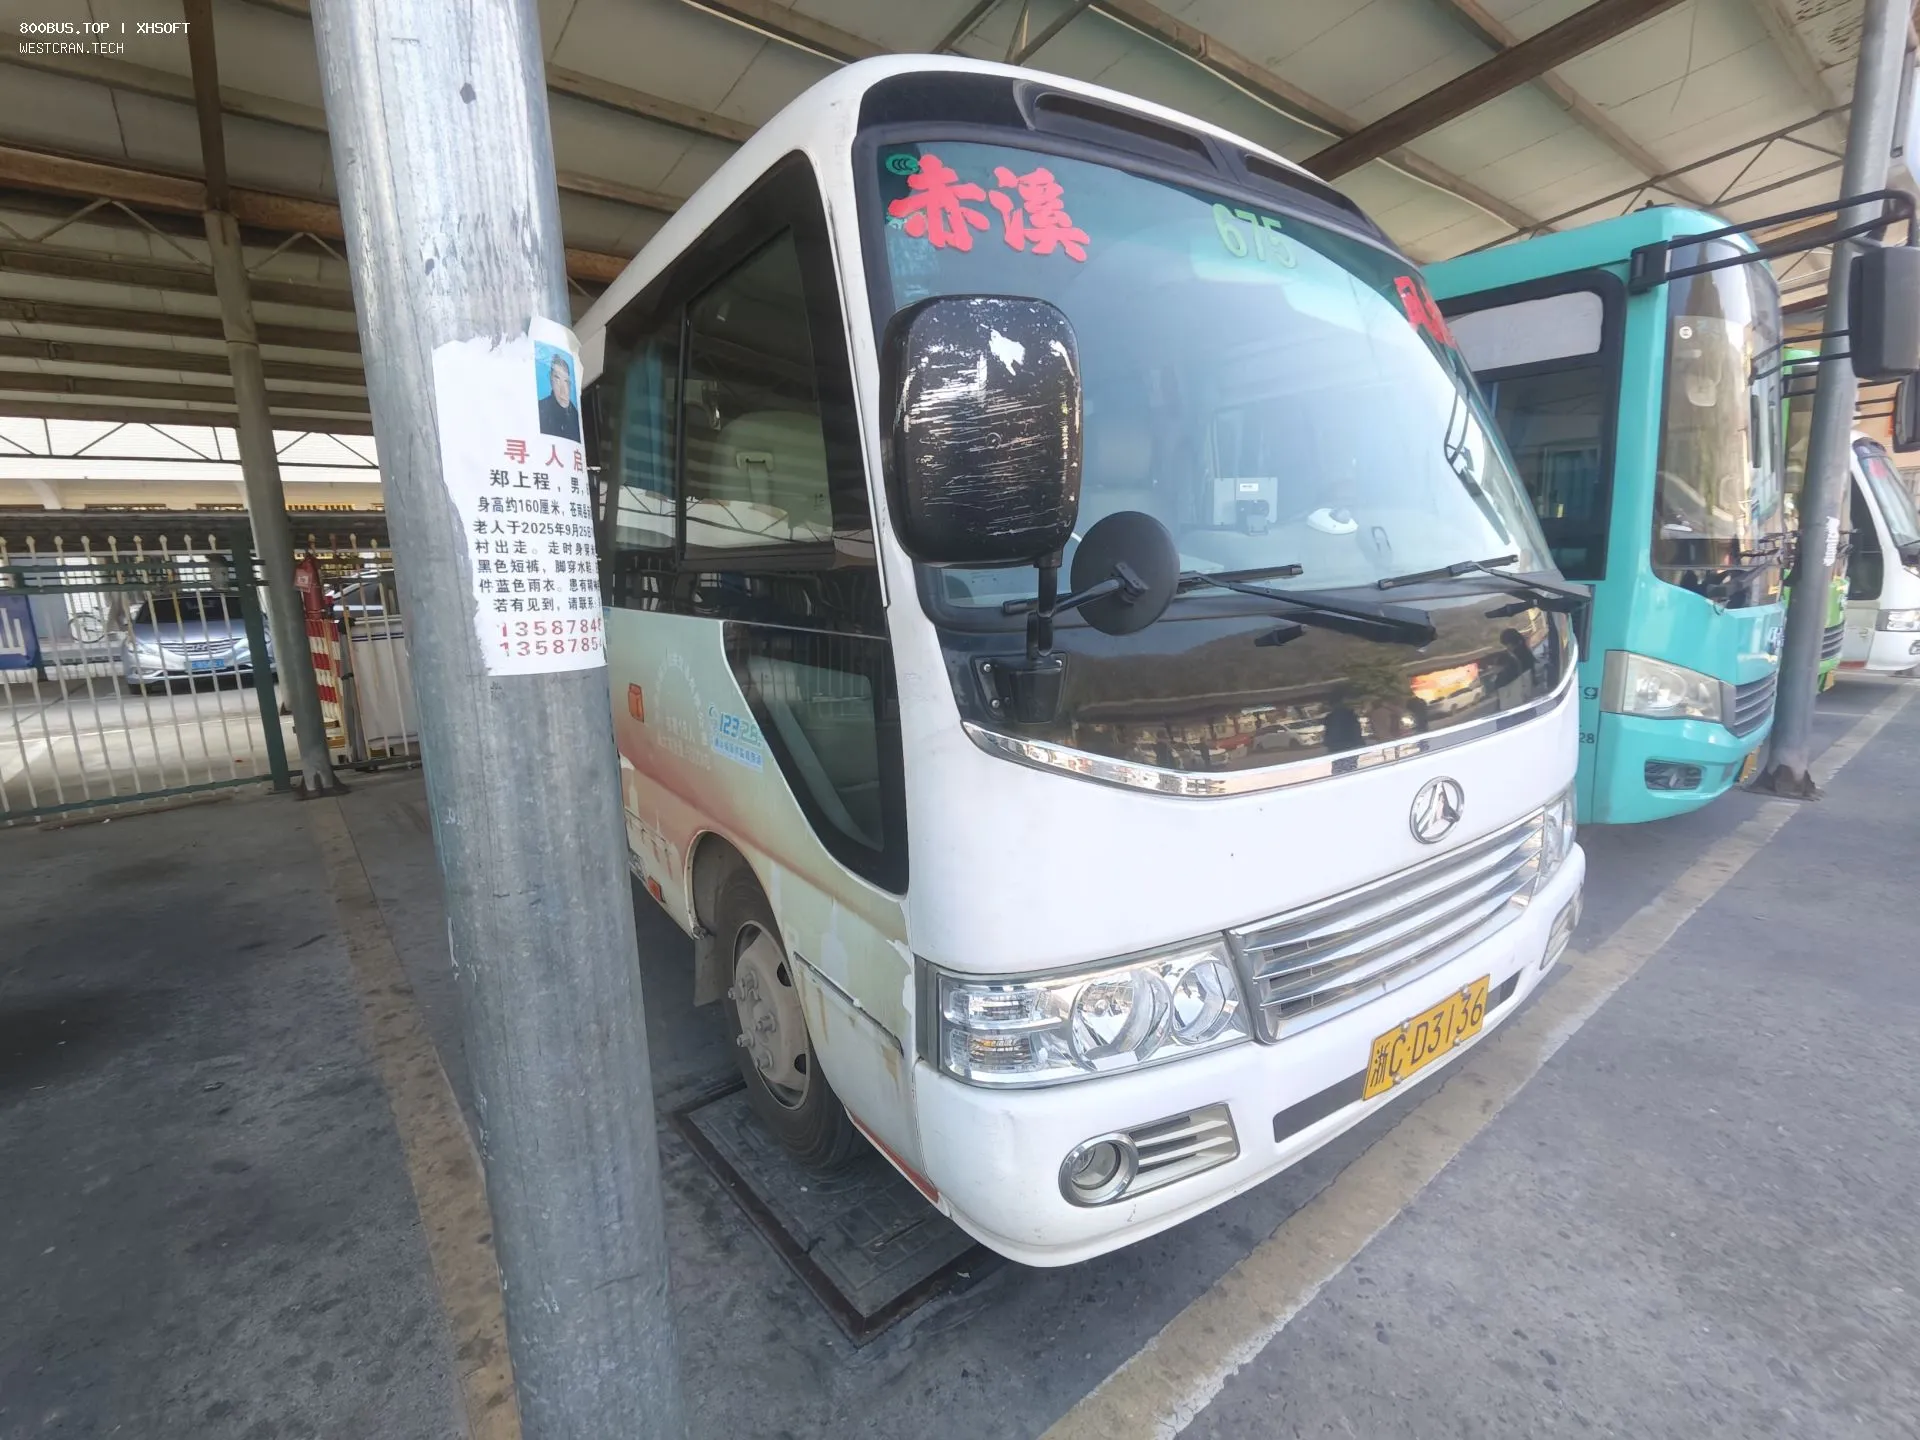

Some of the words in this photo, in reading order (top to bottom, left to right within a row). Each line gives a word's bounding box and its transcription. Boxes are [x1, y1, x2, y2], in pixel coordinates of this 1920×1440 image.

[888, 153, 1091, 263] 赤溪
[1212, 203, 1299, 269] 675
[500, 637, 602, 657] 1358785
